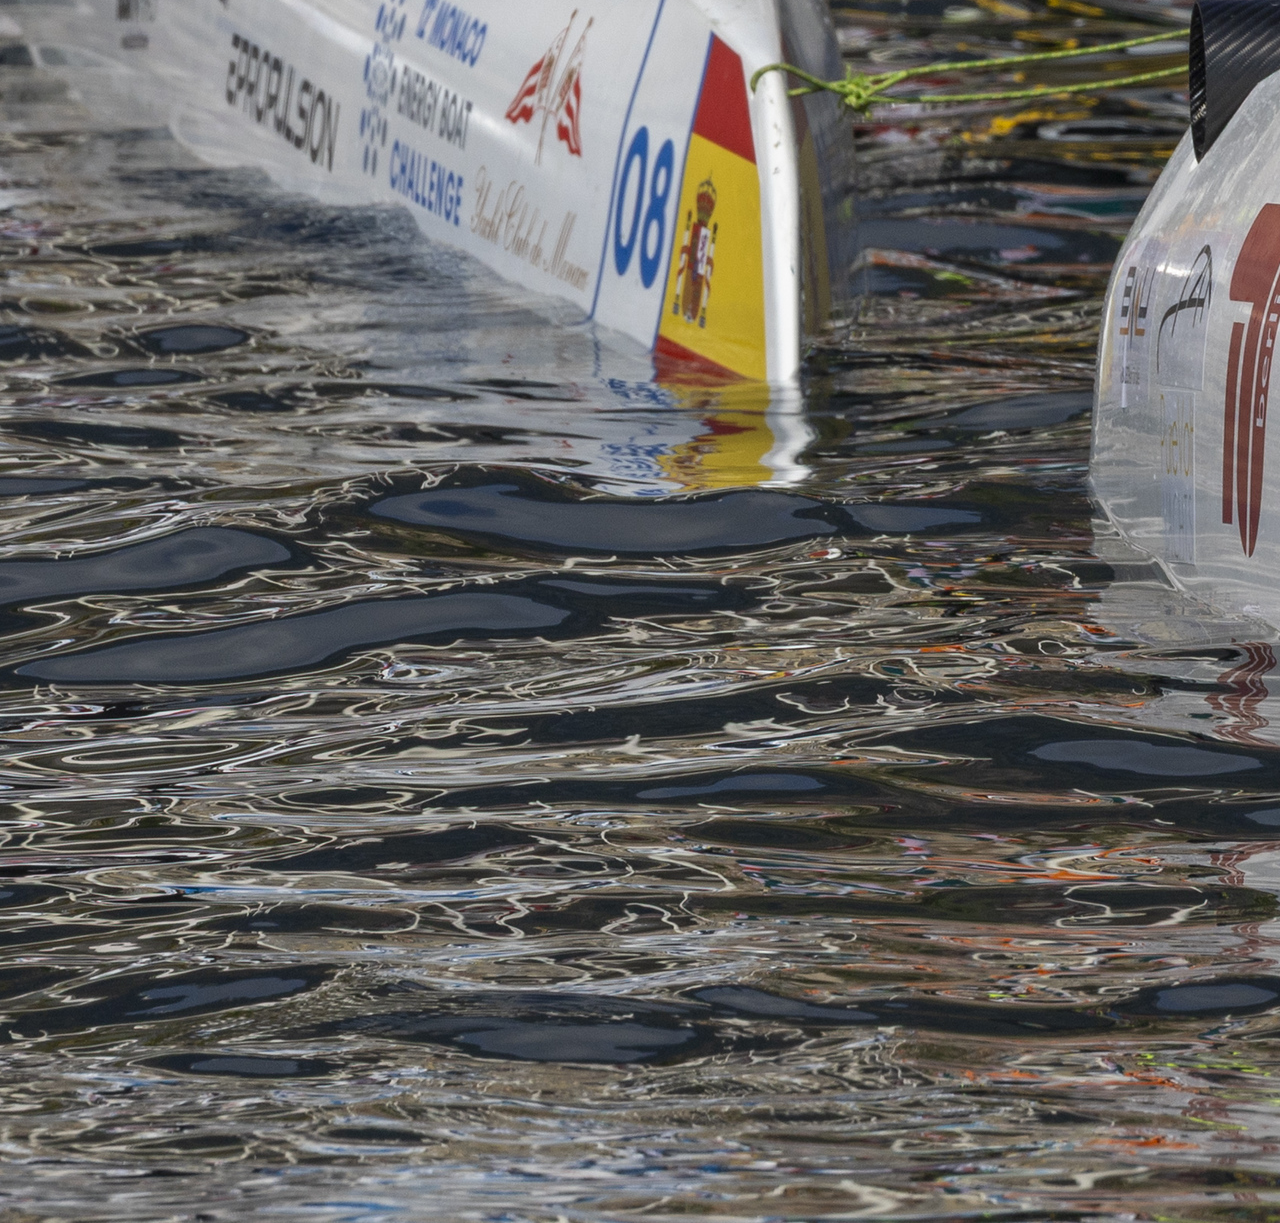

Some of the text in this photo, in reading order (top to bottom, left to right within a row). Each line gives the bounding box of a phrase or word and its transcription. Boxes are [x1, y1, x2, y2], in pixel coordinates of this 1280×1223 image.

[428, 0, 488, 68] MONACO
[225, 32, 340, 173] EPROPULSION
[397, 64, 473, 151] ENERGY BOAT
[390, 138, 464, 228] CHALLENGE
[614, 125, 675, 290] 08
